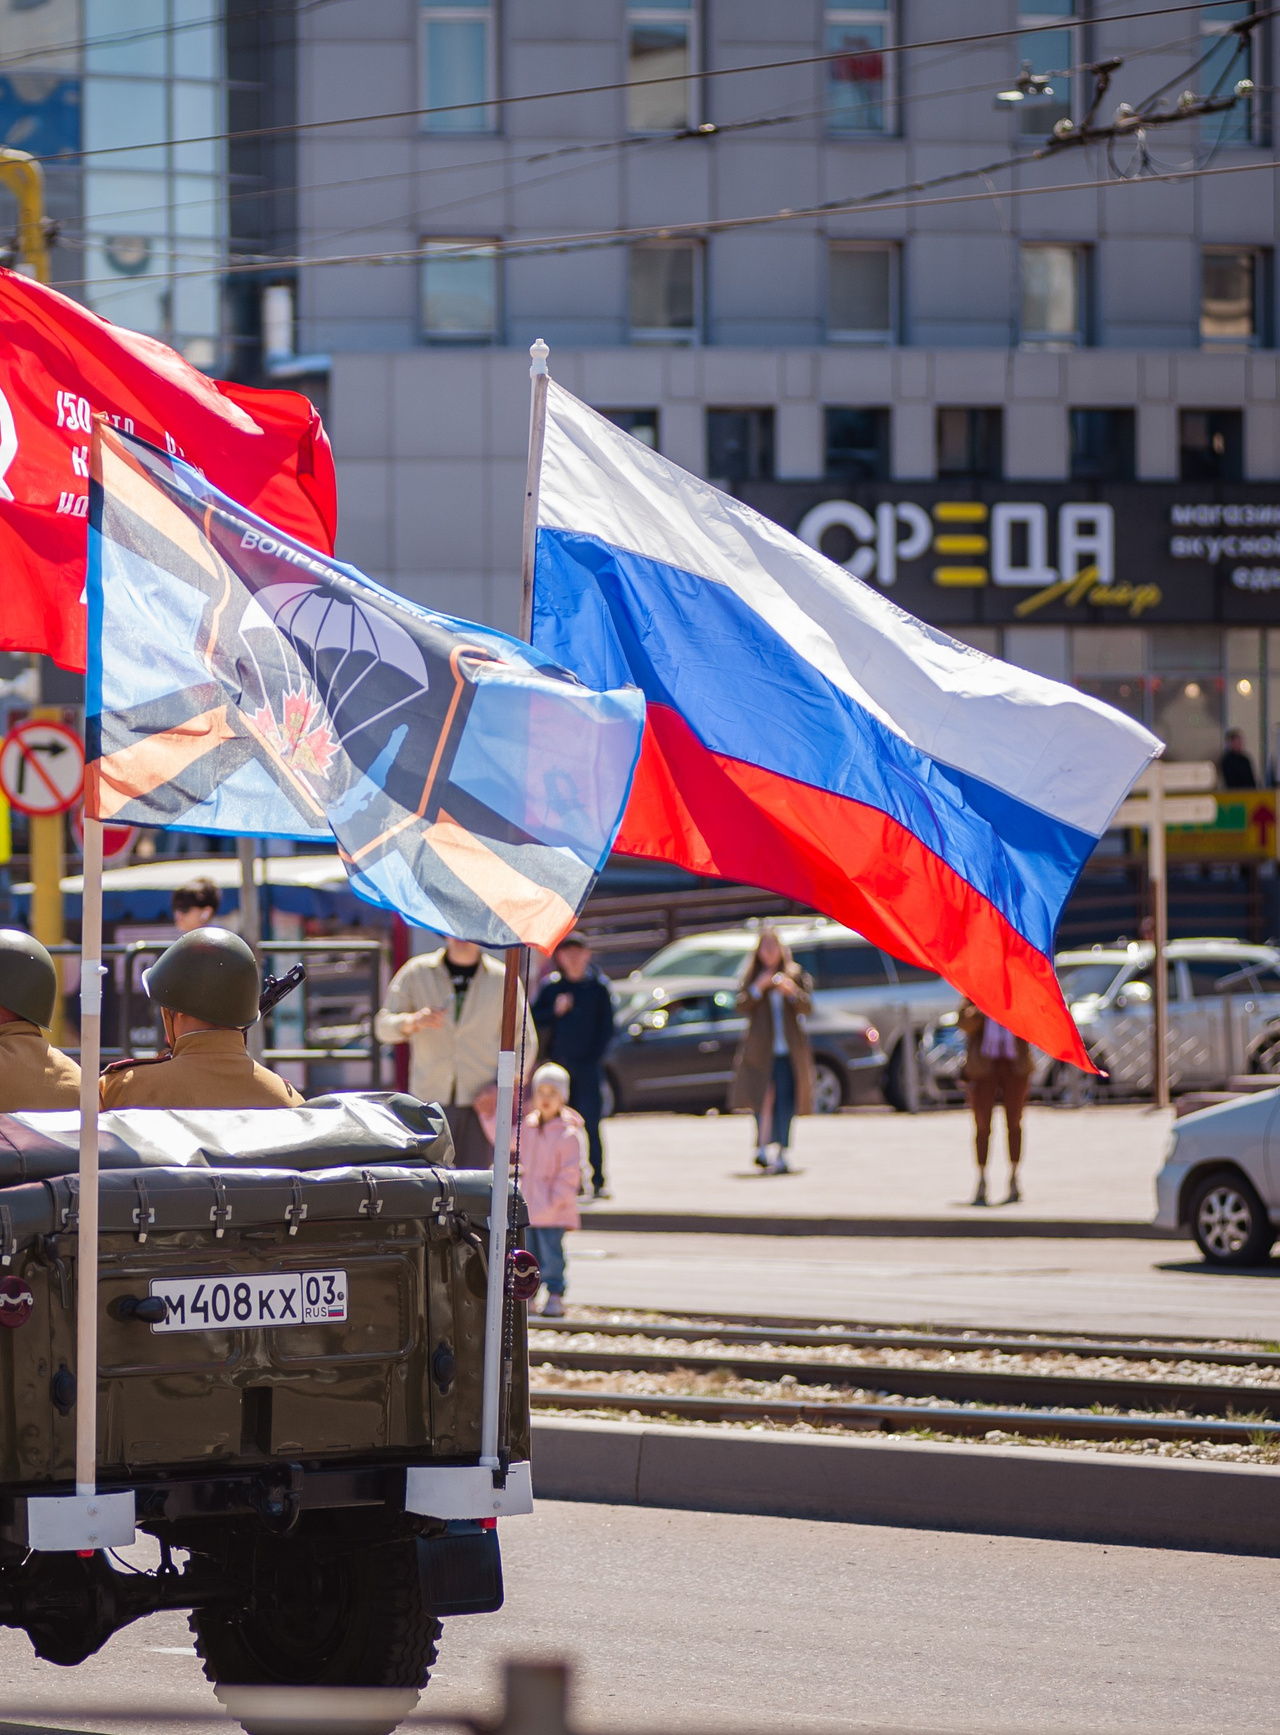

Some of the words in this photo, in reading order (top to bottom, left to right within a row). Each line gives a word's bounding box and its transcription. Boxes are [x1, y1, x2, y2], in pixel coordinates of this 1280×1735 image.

[56, 390, 92, 434] 150
[796, 499, 1115, 587] СРЕДА
[306, 1275, 336, 1306] 03
[305, 1306, 328, 1318] RUS
